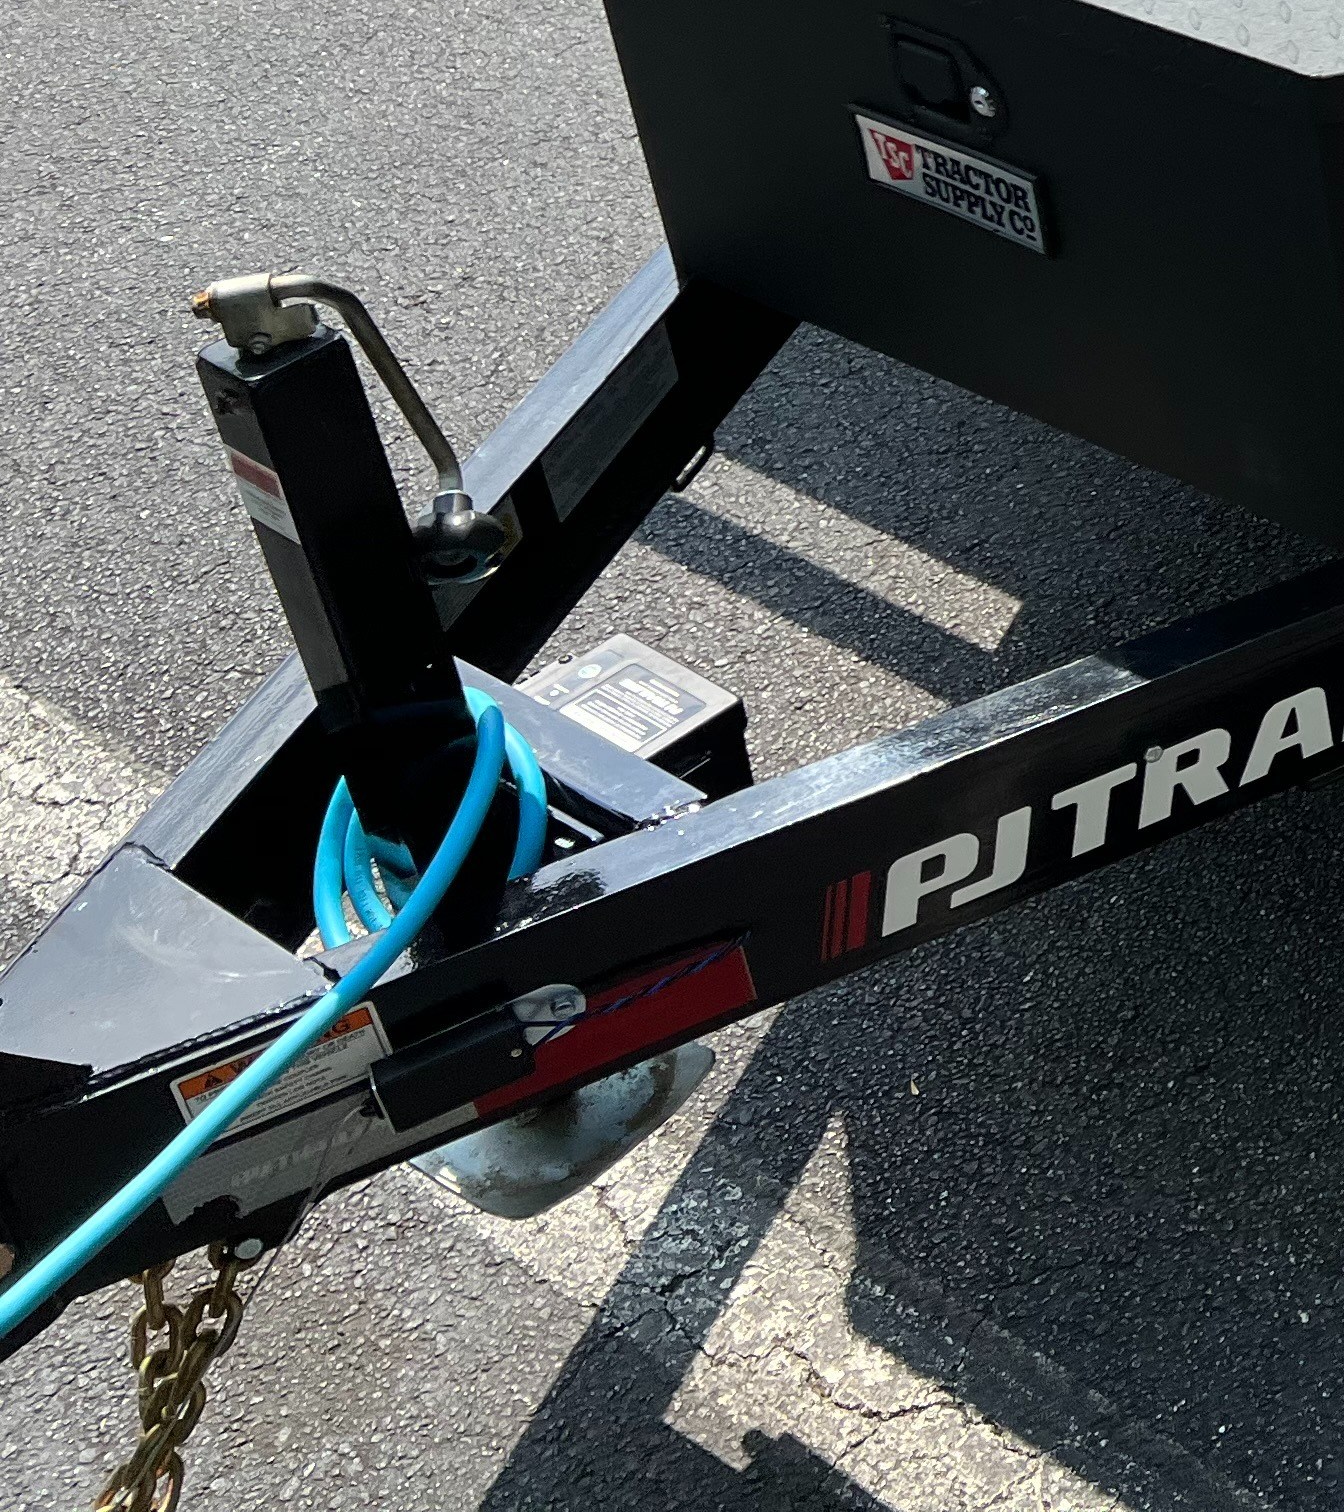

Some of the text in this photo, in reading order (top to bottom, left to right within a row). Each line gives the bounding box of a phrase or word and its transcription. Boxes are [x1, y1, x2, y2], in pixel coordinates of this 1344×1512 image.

[871, 130, 913, 180] TSC
[914, 143, 1032, 213] TRACTOR
[922, 171, 1006, 228] SUPPLY
[881, 806, 1032, 938] PJ
